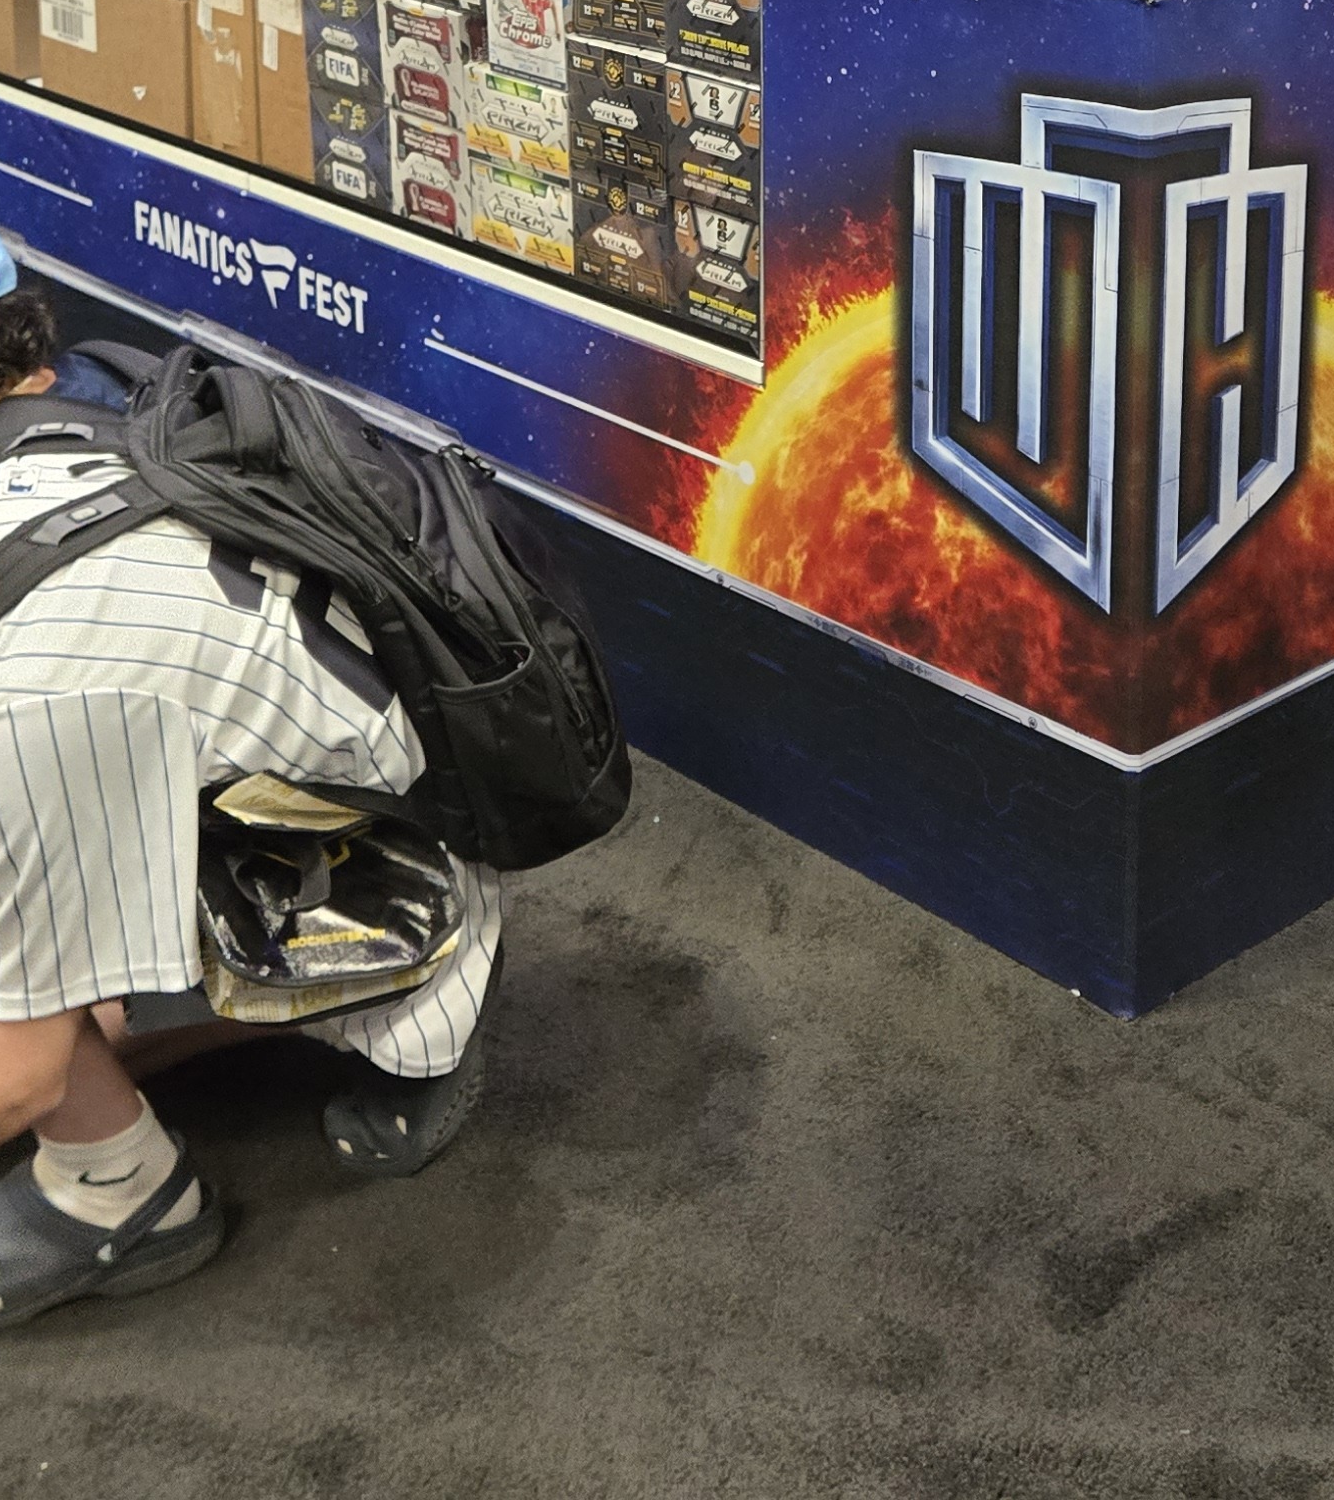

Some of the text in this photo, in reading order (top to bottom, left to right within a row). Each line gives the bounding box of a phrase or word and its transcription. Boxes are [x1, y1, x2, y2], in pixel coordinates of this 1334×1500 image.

[692, 4, 734, 21] PRIZM
[499, 21, 552, 48] Chrome
[328, 57, 354, 79] FIFA
[335, 168, 362, 191] FIFA
[134, 200, 368, 334] FANATICS FEST
